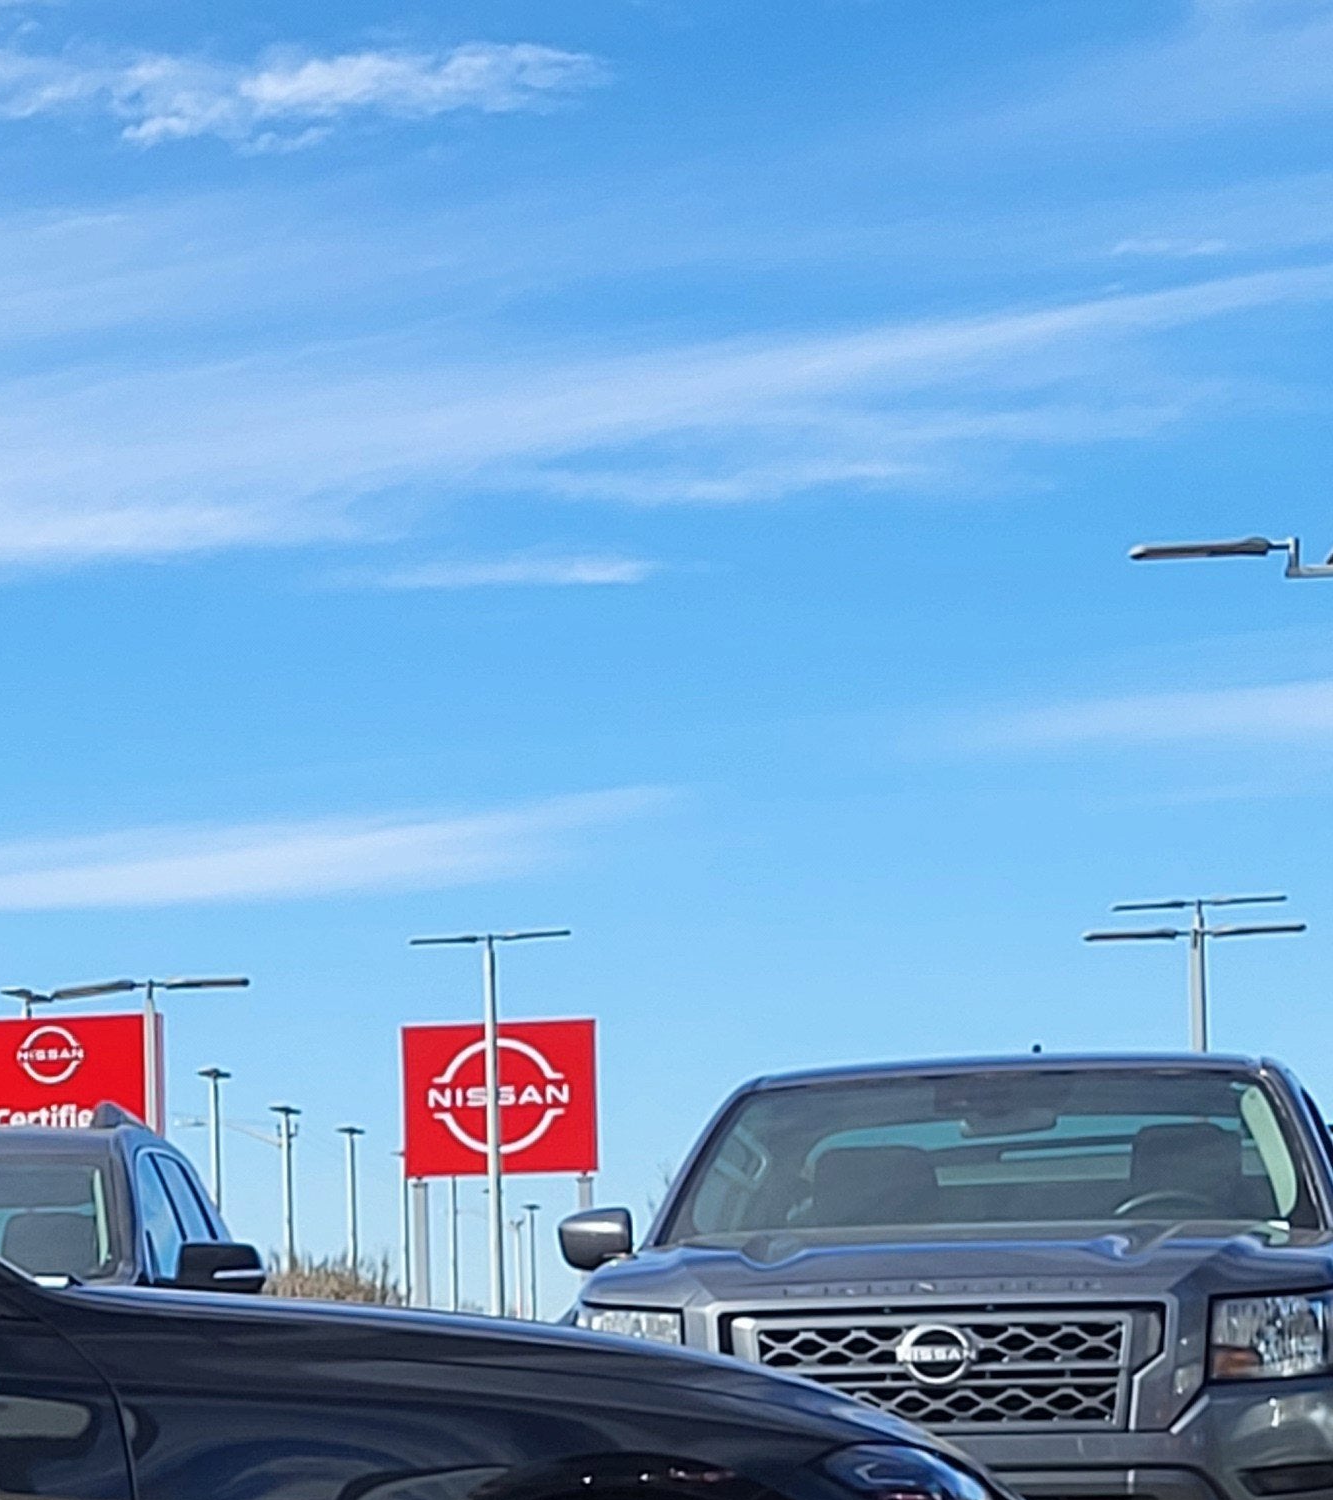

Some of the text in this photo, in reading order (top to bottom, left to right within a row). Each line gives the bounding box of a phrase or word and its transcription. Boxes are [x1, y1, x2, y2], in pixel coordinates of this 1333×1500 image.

[16, 1047, 84, 1061] NISSAN
[427, 1084, 570, 1108] NISSAN
[895, 1345, 977, 1362] NISSAN
